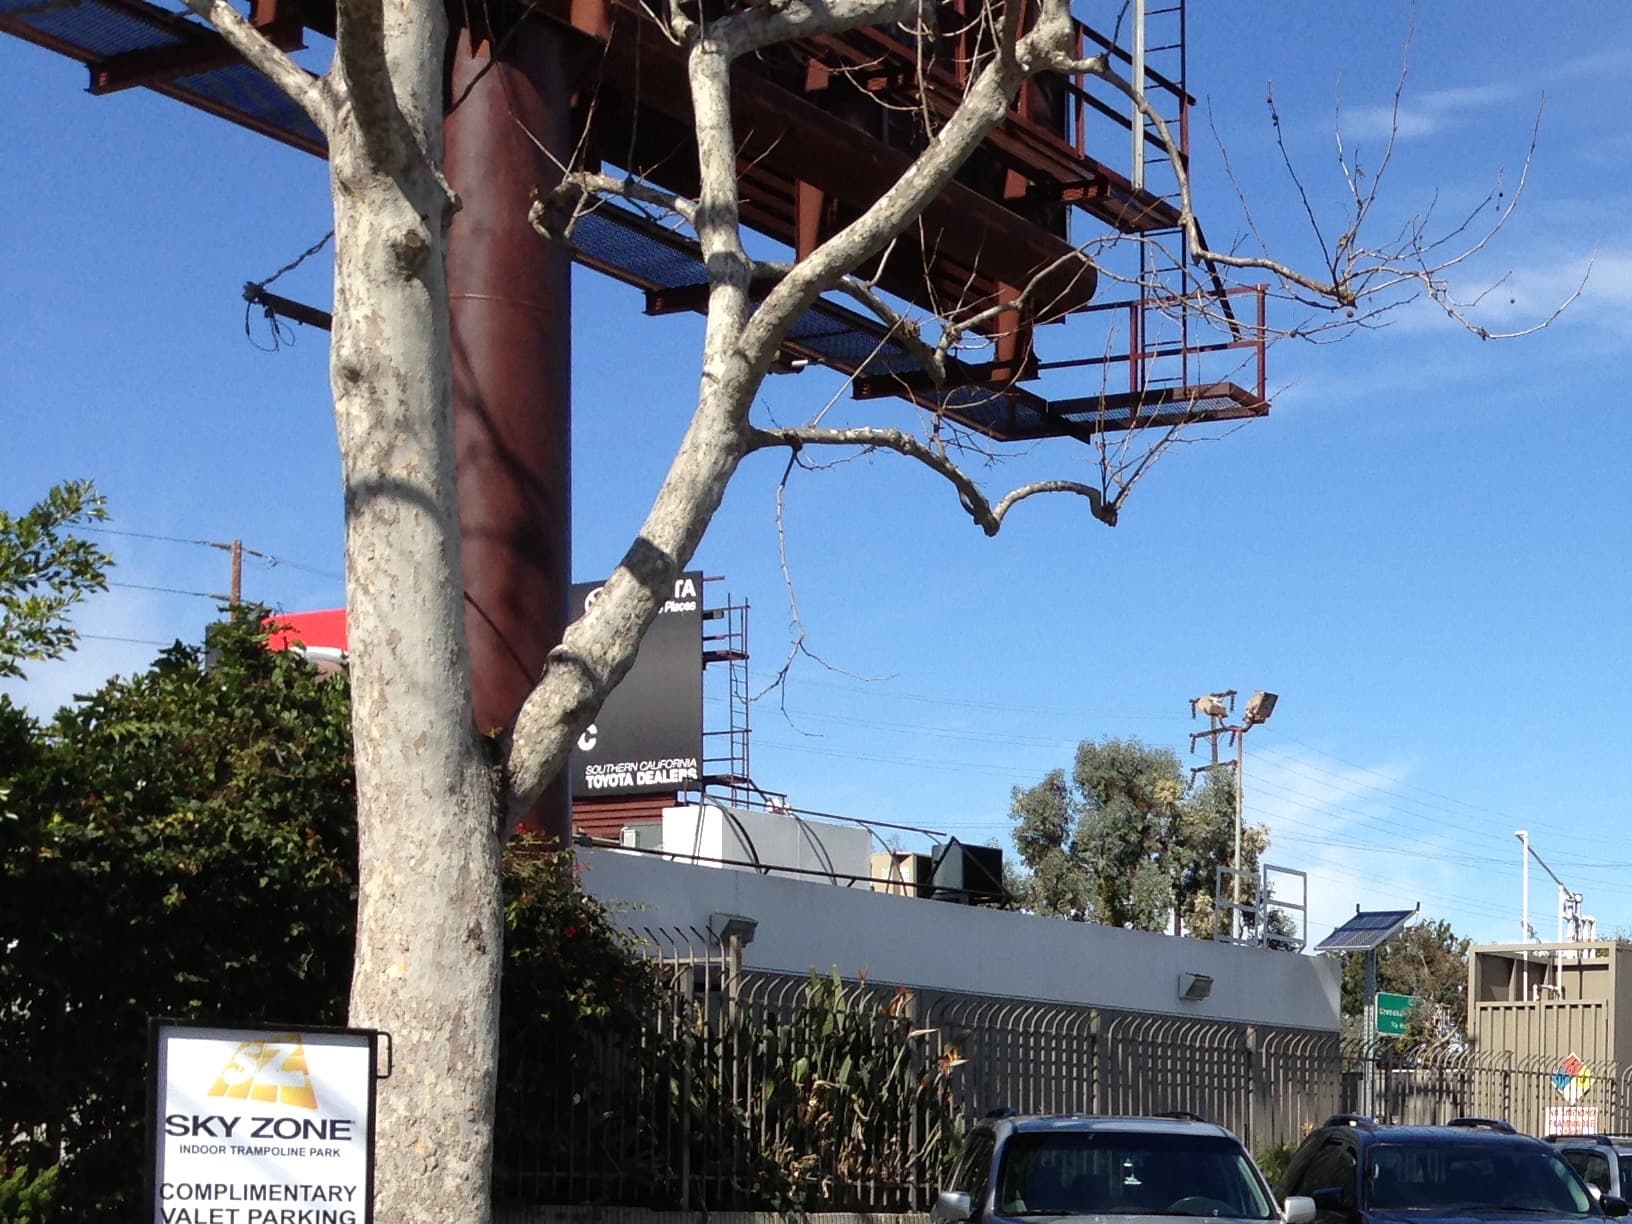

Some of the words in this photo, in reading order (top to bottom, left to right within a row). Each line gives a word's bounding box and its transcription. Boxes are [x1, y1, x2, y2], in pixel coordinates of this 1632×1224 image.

[585, 762, 638, 775] SOUTHERN
[640, 757, 697, 771] CALIFORNIA
[585, 772, 634, 789] TOYOTA
[637, 768, 698, 785] DEALERS
[164, 1114, 241, 1138] SKY
[250, 1117, 352, 1141] ZONE
[179, 1144, 226, 1155] INDOOR
[230, 1145, 306, 1157] TRAMPOLINE
[309, 1147, 341, 1158] PARK
[159, 1182, 357, 1202] COMPLIMENTARY
